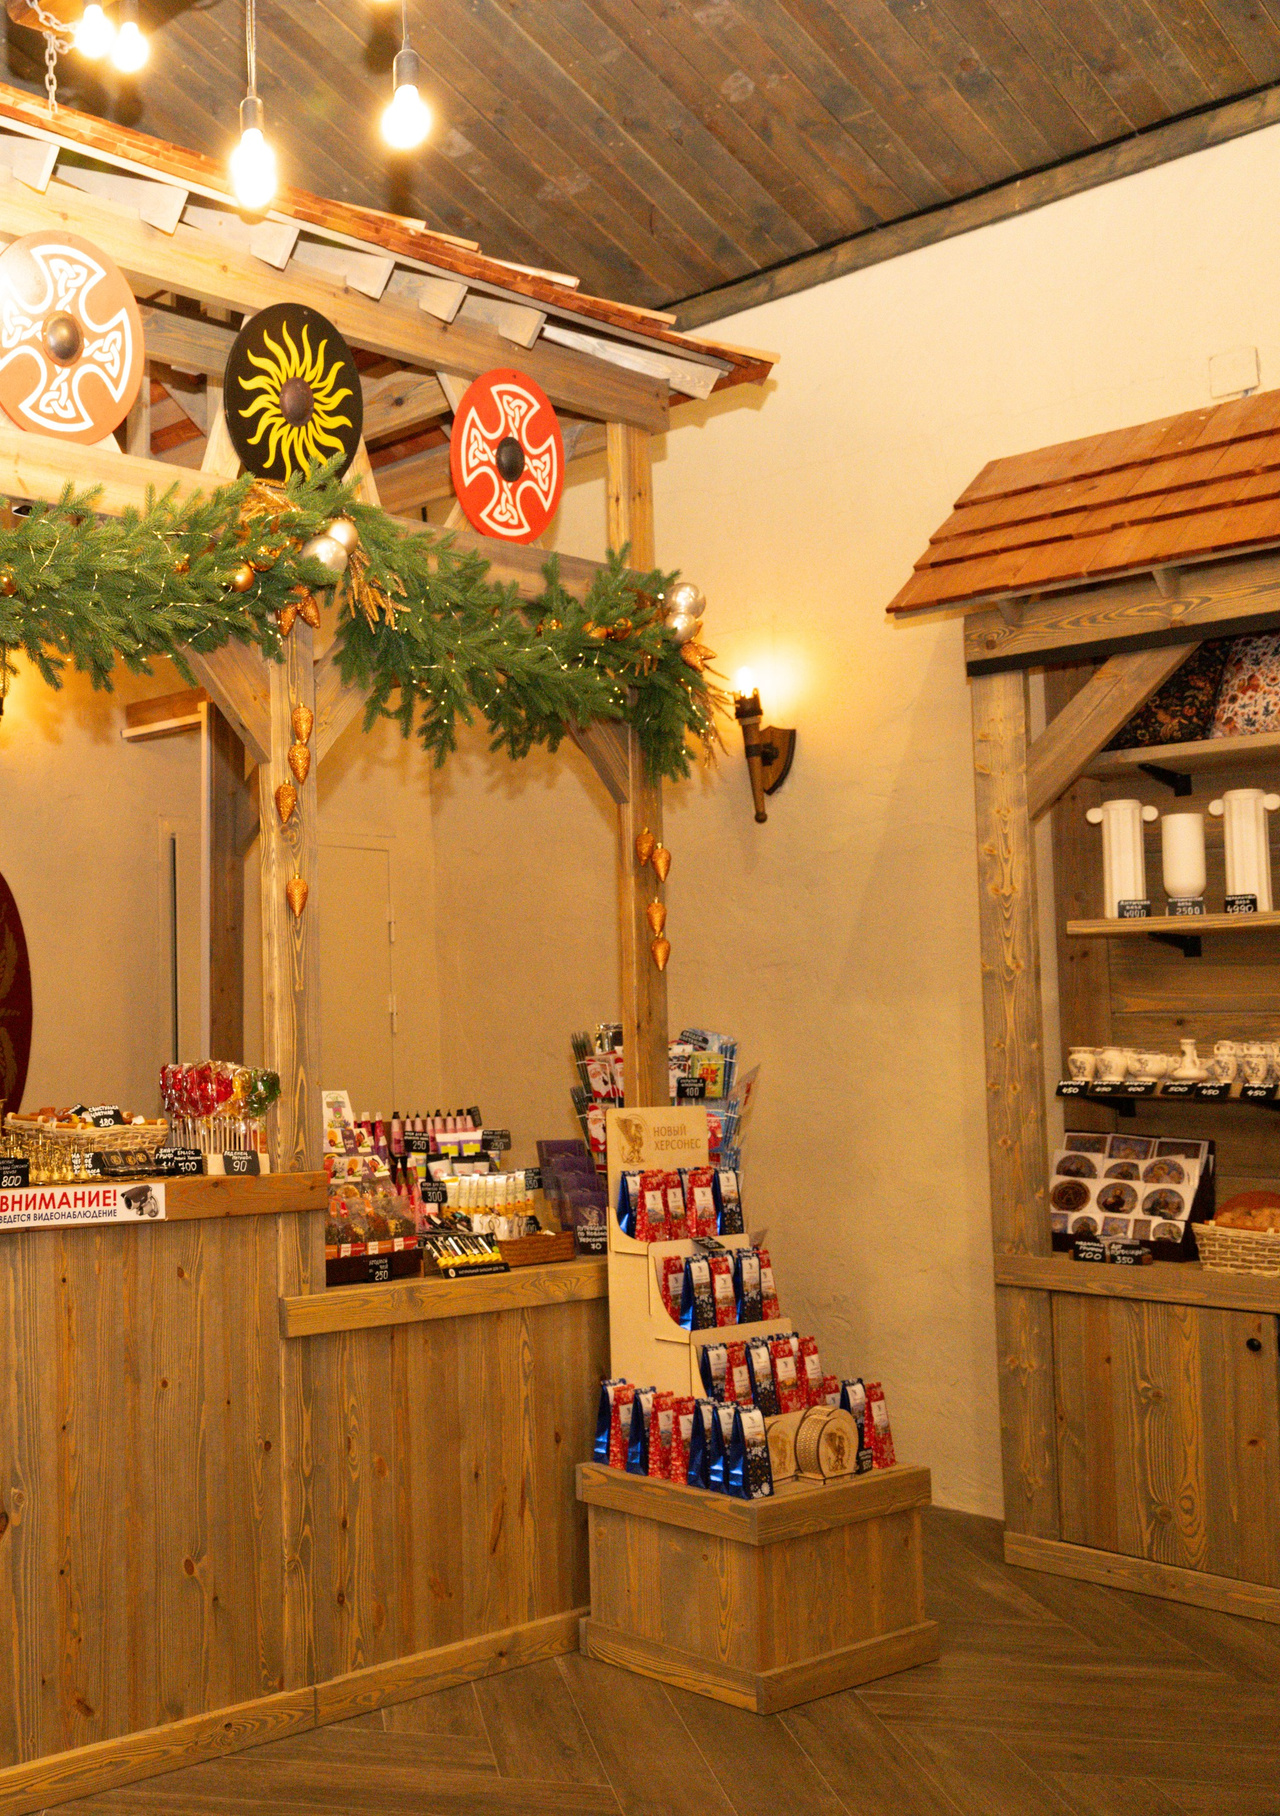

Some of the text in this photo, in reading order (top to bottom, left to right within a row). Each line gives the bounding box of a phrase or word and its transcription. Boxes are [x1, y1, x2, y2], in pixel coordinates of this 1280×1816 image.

[1062, 1086, 1080, 1094] 450
[1201, 1088, 1220, 1096] 450
[1247, 1089, 1267, 1097] 450
[653, 1123, 687, 1137] НОВЫЙ
[654, 1138, 701, 1151] ХЕРСОНЕС
[178, 1161, 197, 1172] 700
[232, 1160, 248, 1172] 90
[1, 1175, 22, 1187] 800
[0, 1189, 117, 1213] ВНИМАНИЕ!
[427, 1191, 443, 1202] 300
[33, 1209, 117, 1221] ВИДЕОНАБЛЮДЕНИЕ
[1115, 1255, 1134, 1264] 350
[375, 1270, 388, 1281] 250
